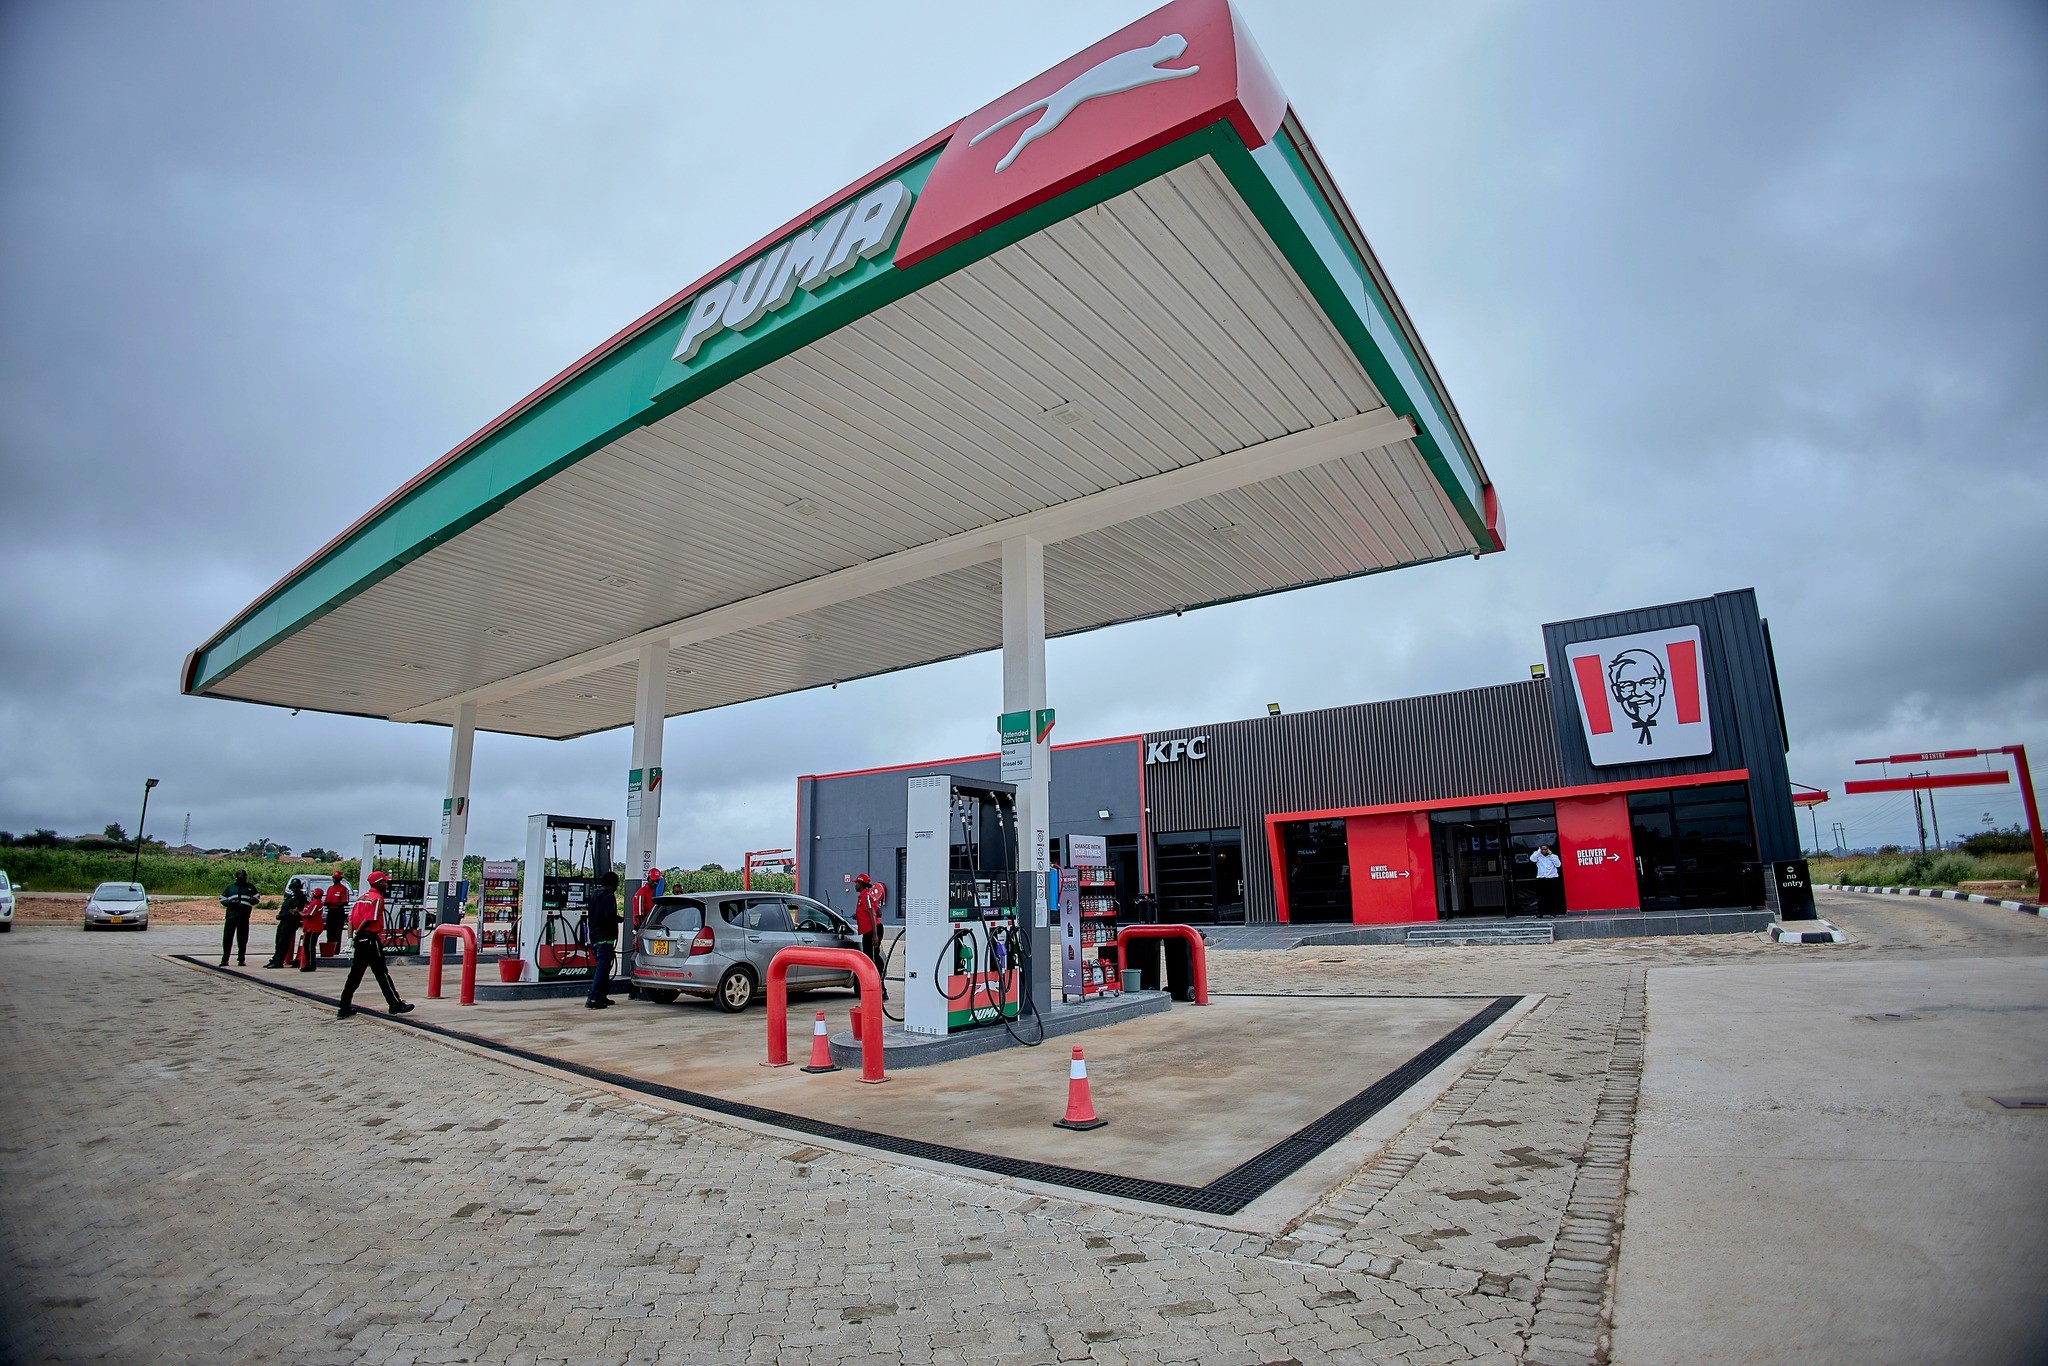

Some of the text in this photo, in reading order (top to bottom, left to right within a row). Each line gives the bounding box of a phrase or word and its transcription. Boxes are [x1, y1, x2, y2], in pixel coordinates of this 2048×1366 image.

[671, 180, 912, 364] PUMA
[1041, 712, 1046, 722] 1
[1003, 729, 1029, 738] Attended
[1146, 735, 1206, 765] KFC
[1929, 752, 1946, 760] ENTRY
[1086, 849, 1101, 857] TIMES
[1577, 848, 1607, 858] DELIVERY
[1578, 856, 1604, 866] PICK UP
[1370, 871, 1398, 880] WELCOME
[1782, 880, 1803, 888] entry
[558, 967, 588, 976] PUMA
